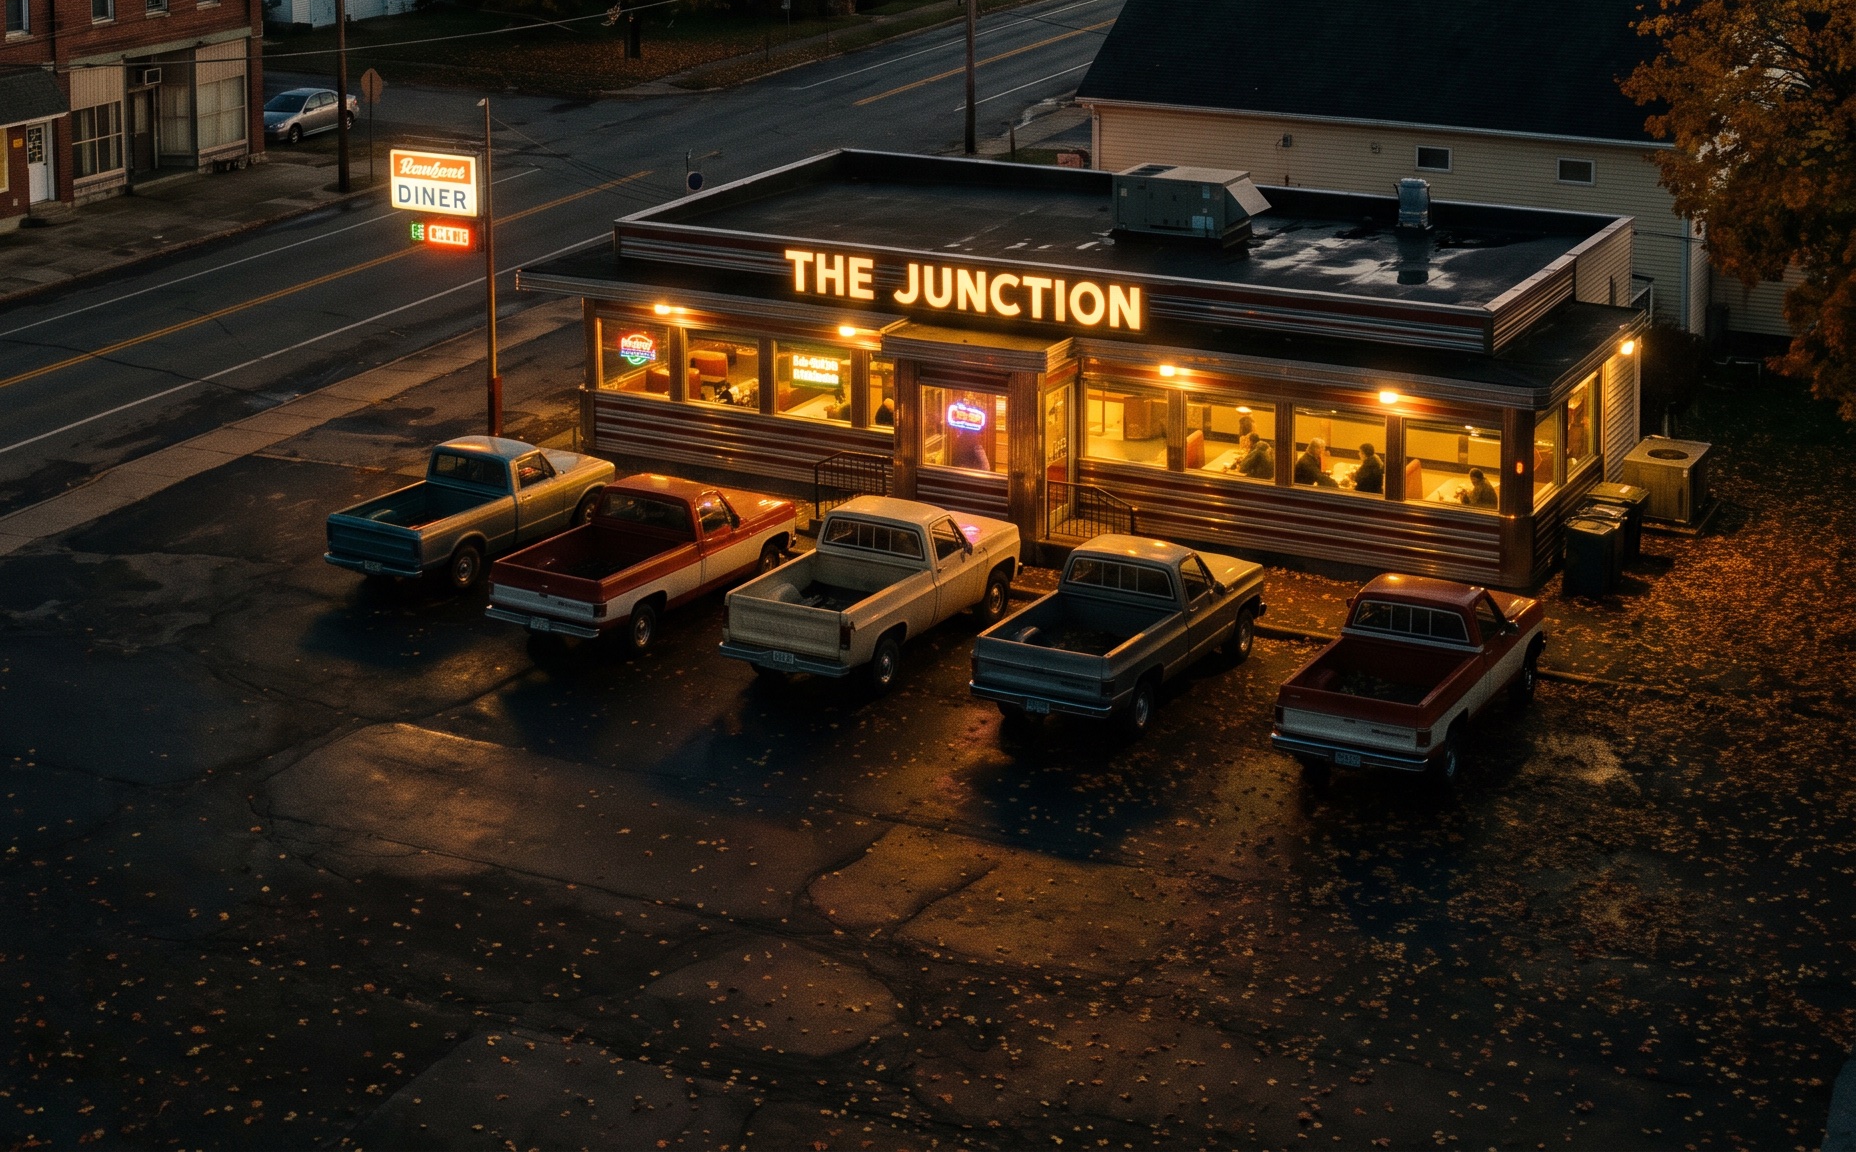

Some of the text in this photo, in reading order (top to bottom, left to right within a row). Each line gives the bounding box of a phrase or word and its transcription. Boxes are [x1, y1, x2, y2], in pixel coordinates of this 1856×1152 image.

[398, 184, 467, 210] DINER
[785, 250, 1141, 330] THE JUNCTION
